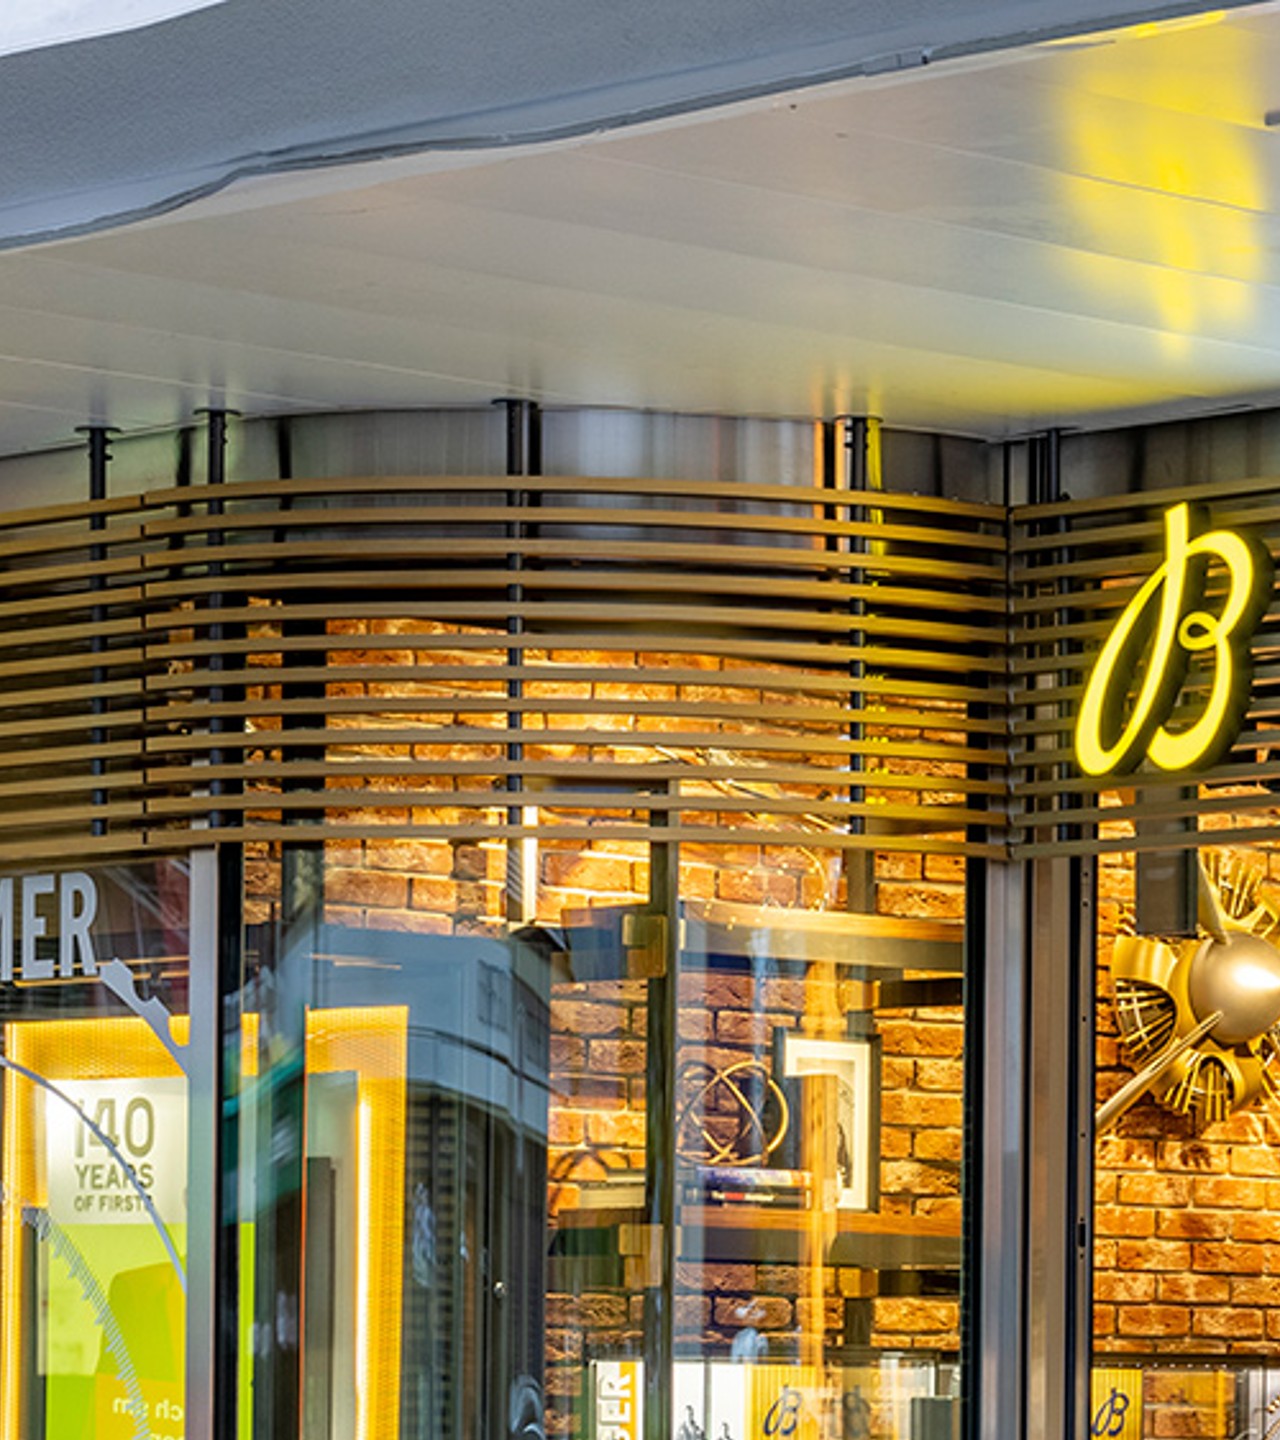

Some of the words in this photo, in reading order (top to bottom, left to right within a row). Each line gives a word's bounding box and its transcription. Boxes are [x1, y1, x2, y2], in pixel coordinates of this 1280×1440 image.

[75, 1097, 155, 1158] 140
[75, 1164, 154, 1189] YEARS
[74, 1195, 95, 1212] OF
[99, 1195, 152, 1213] FIRST
